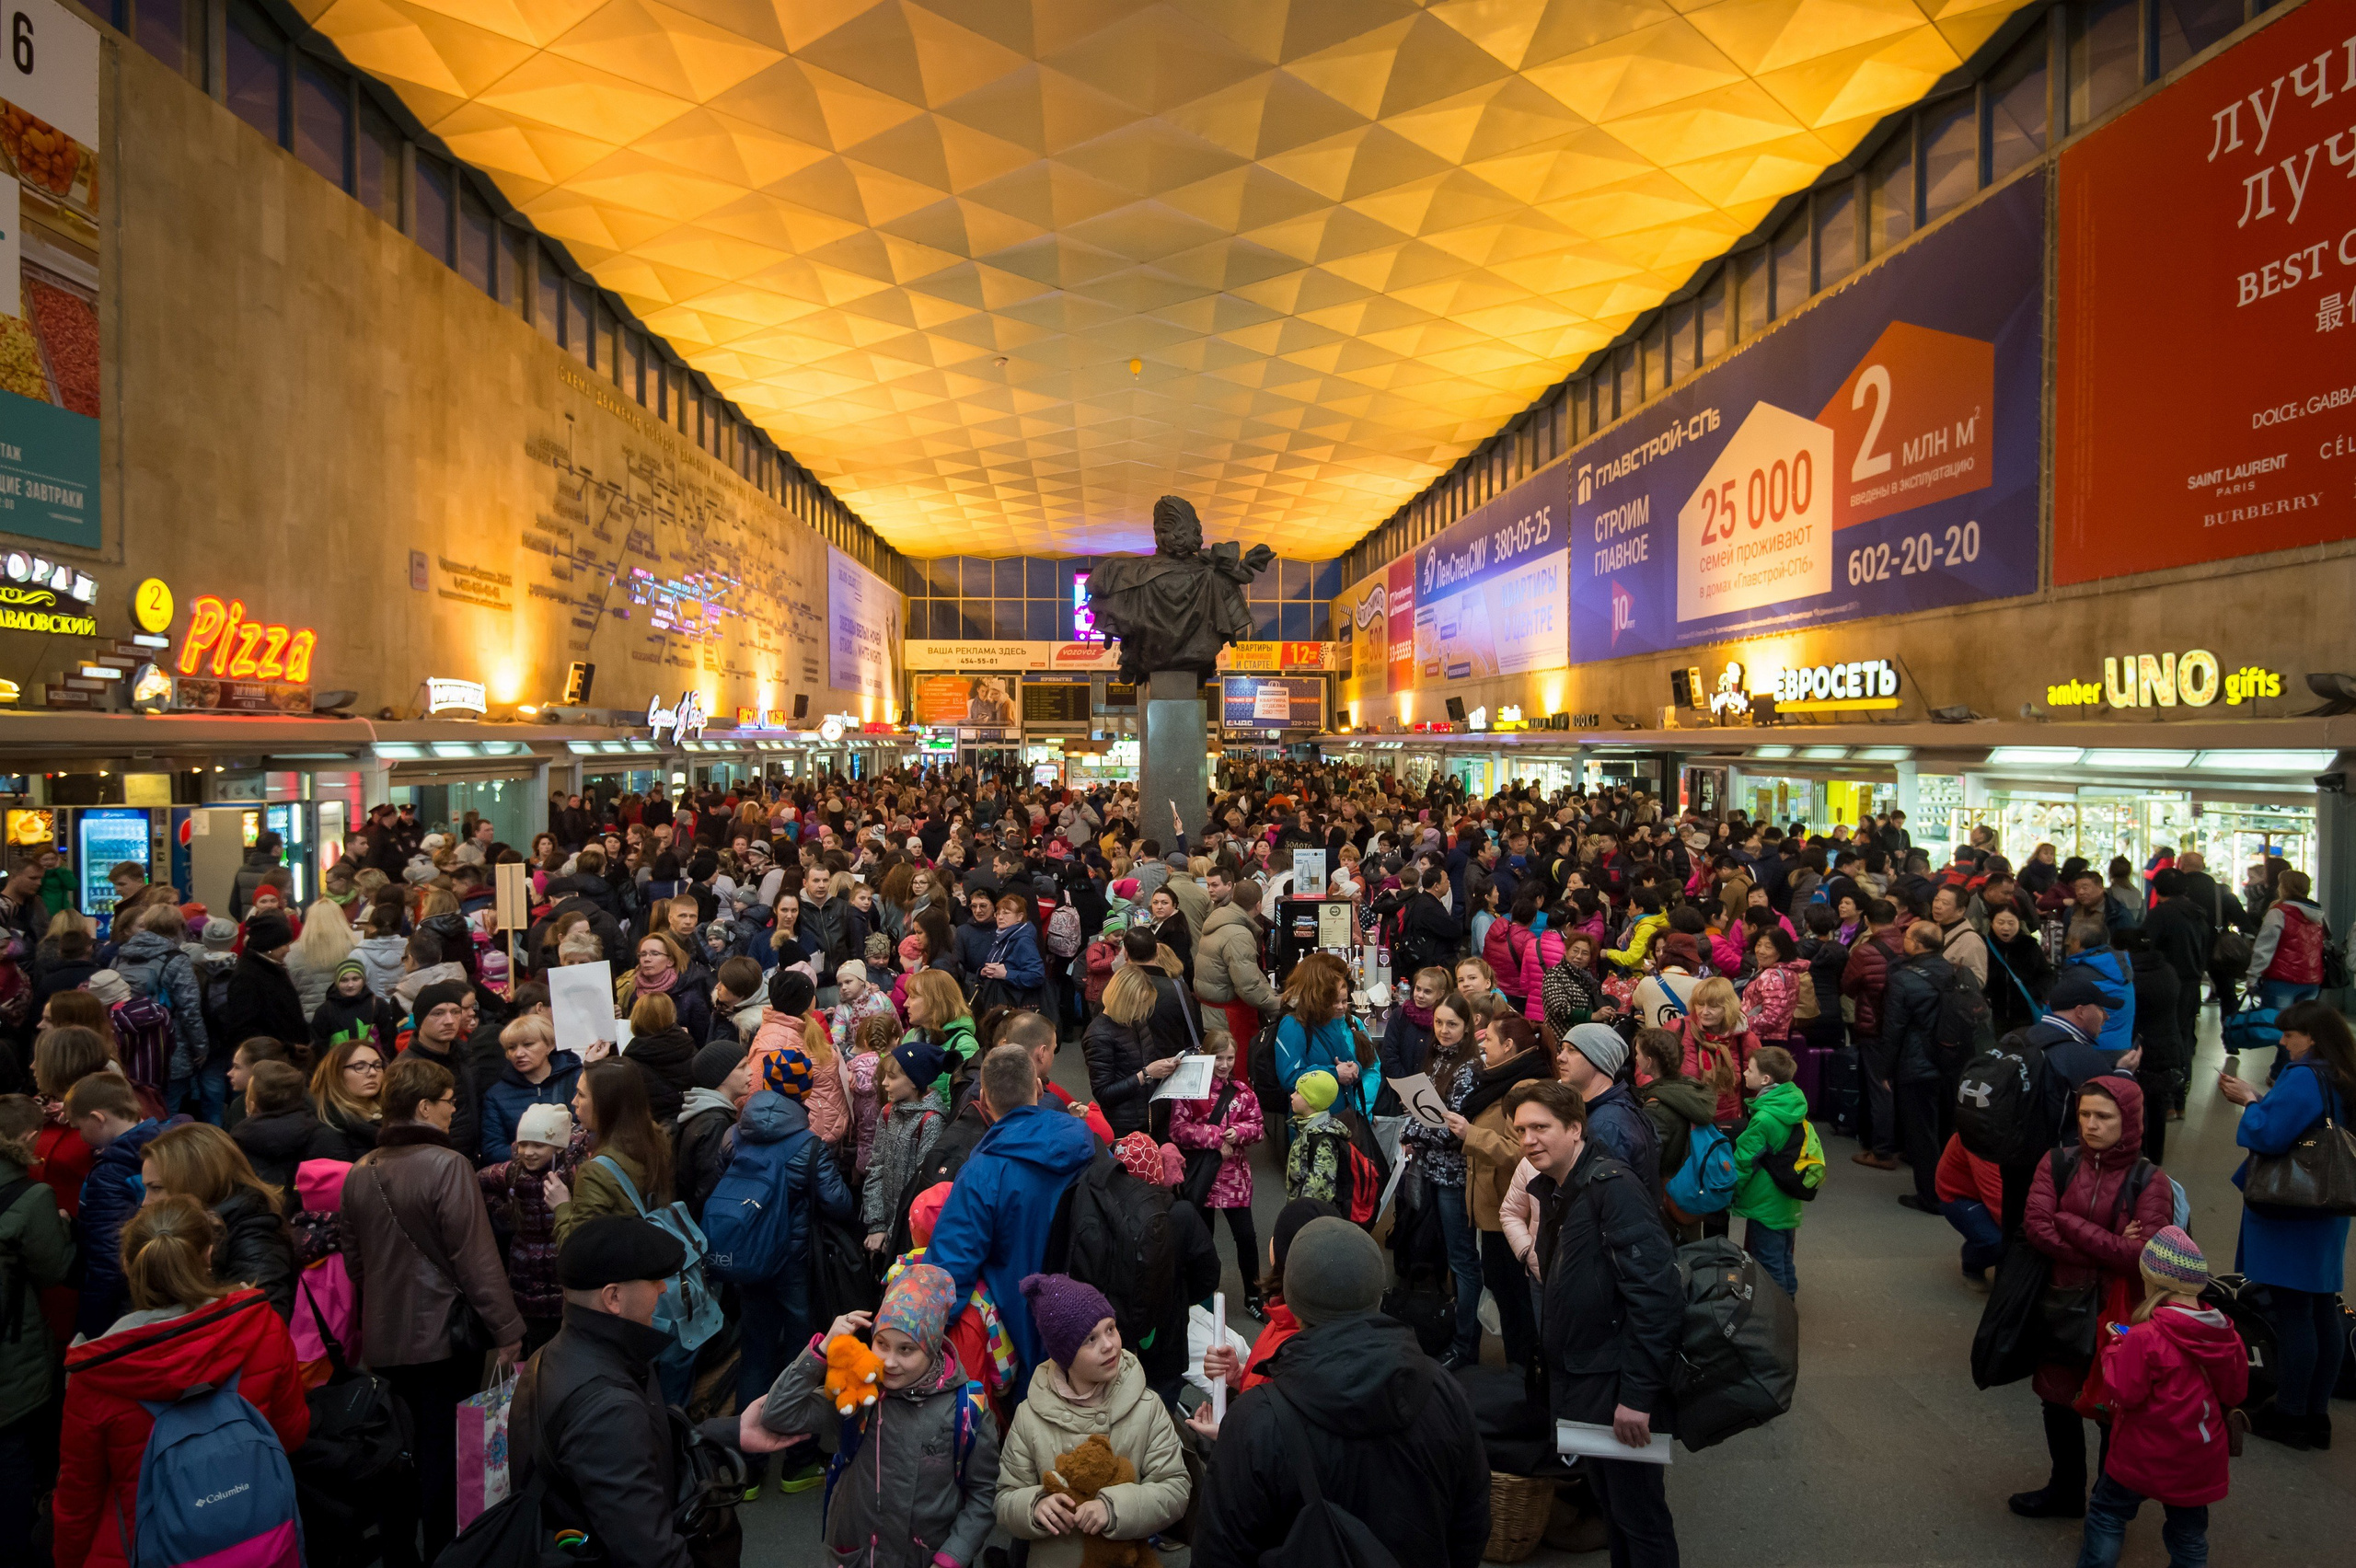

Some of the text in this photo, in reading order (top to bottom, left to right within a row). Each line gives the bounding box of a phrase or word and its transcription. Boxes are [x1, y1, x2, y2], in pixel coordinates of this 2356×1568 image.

[2236, 240, 2328, 307] BEST
[1851, 364, 1891, 483] 2
[2252, 402, 2297, 429] DOLCE
[2187, 454, 2289, 490] SAINT LAURENT
[2215, 480, 2256, 497] PARIS
[25, 479, 84, 510] ЗАВТРАКИ
[1701, 449, 1813, 547] 25 000
[2203, 491, 2324, 528] BURBERRY
[1494, 505, 1551, 564] 380-05-25
[1594, 494, 1650, 544] СТРОИМ
[1594, 533, 1648, 577] ГЛАВНОЕ
[1699, 524, 1813, 574] семей проживают
[1847, 520, 1981, 586] 602-20-20
[149, 585, 161, 610] 2
[1500, 564, 1558, 609] КВАРТИРЫ
[1706, 577, 1732, 598] домах
[177, 594, 318, 685] Pizza
[1512, 604, 1553, 645] ЦЕНТРЕ
[999, 647, 1026, 655] ЗДЕСЬ
[1243, 661, 1274, 669] СТАРТЕ!
[1773, 659, 1900, 703] ЕВРОСЕТЬ
[2047, 679, 2102, 706] amber
[2225, 667, 2281, 706] gifts
[205, 1482, 250, 1505] Columbia
